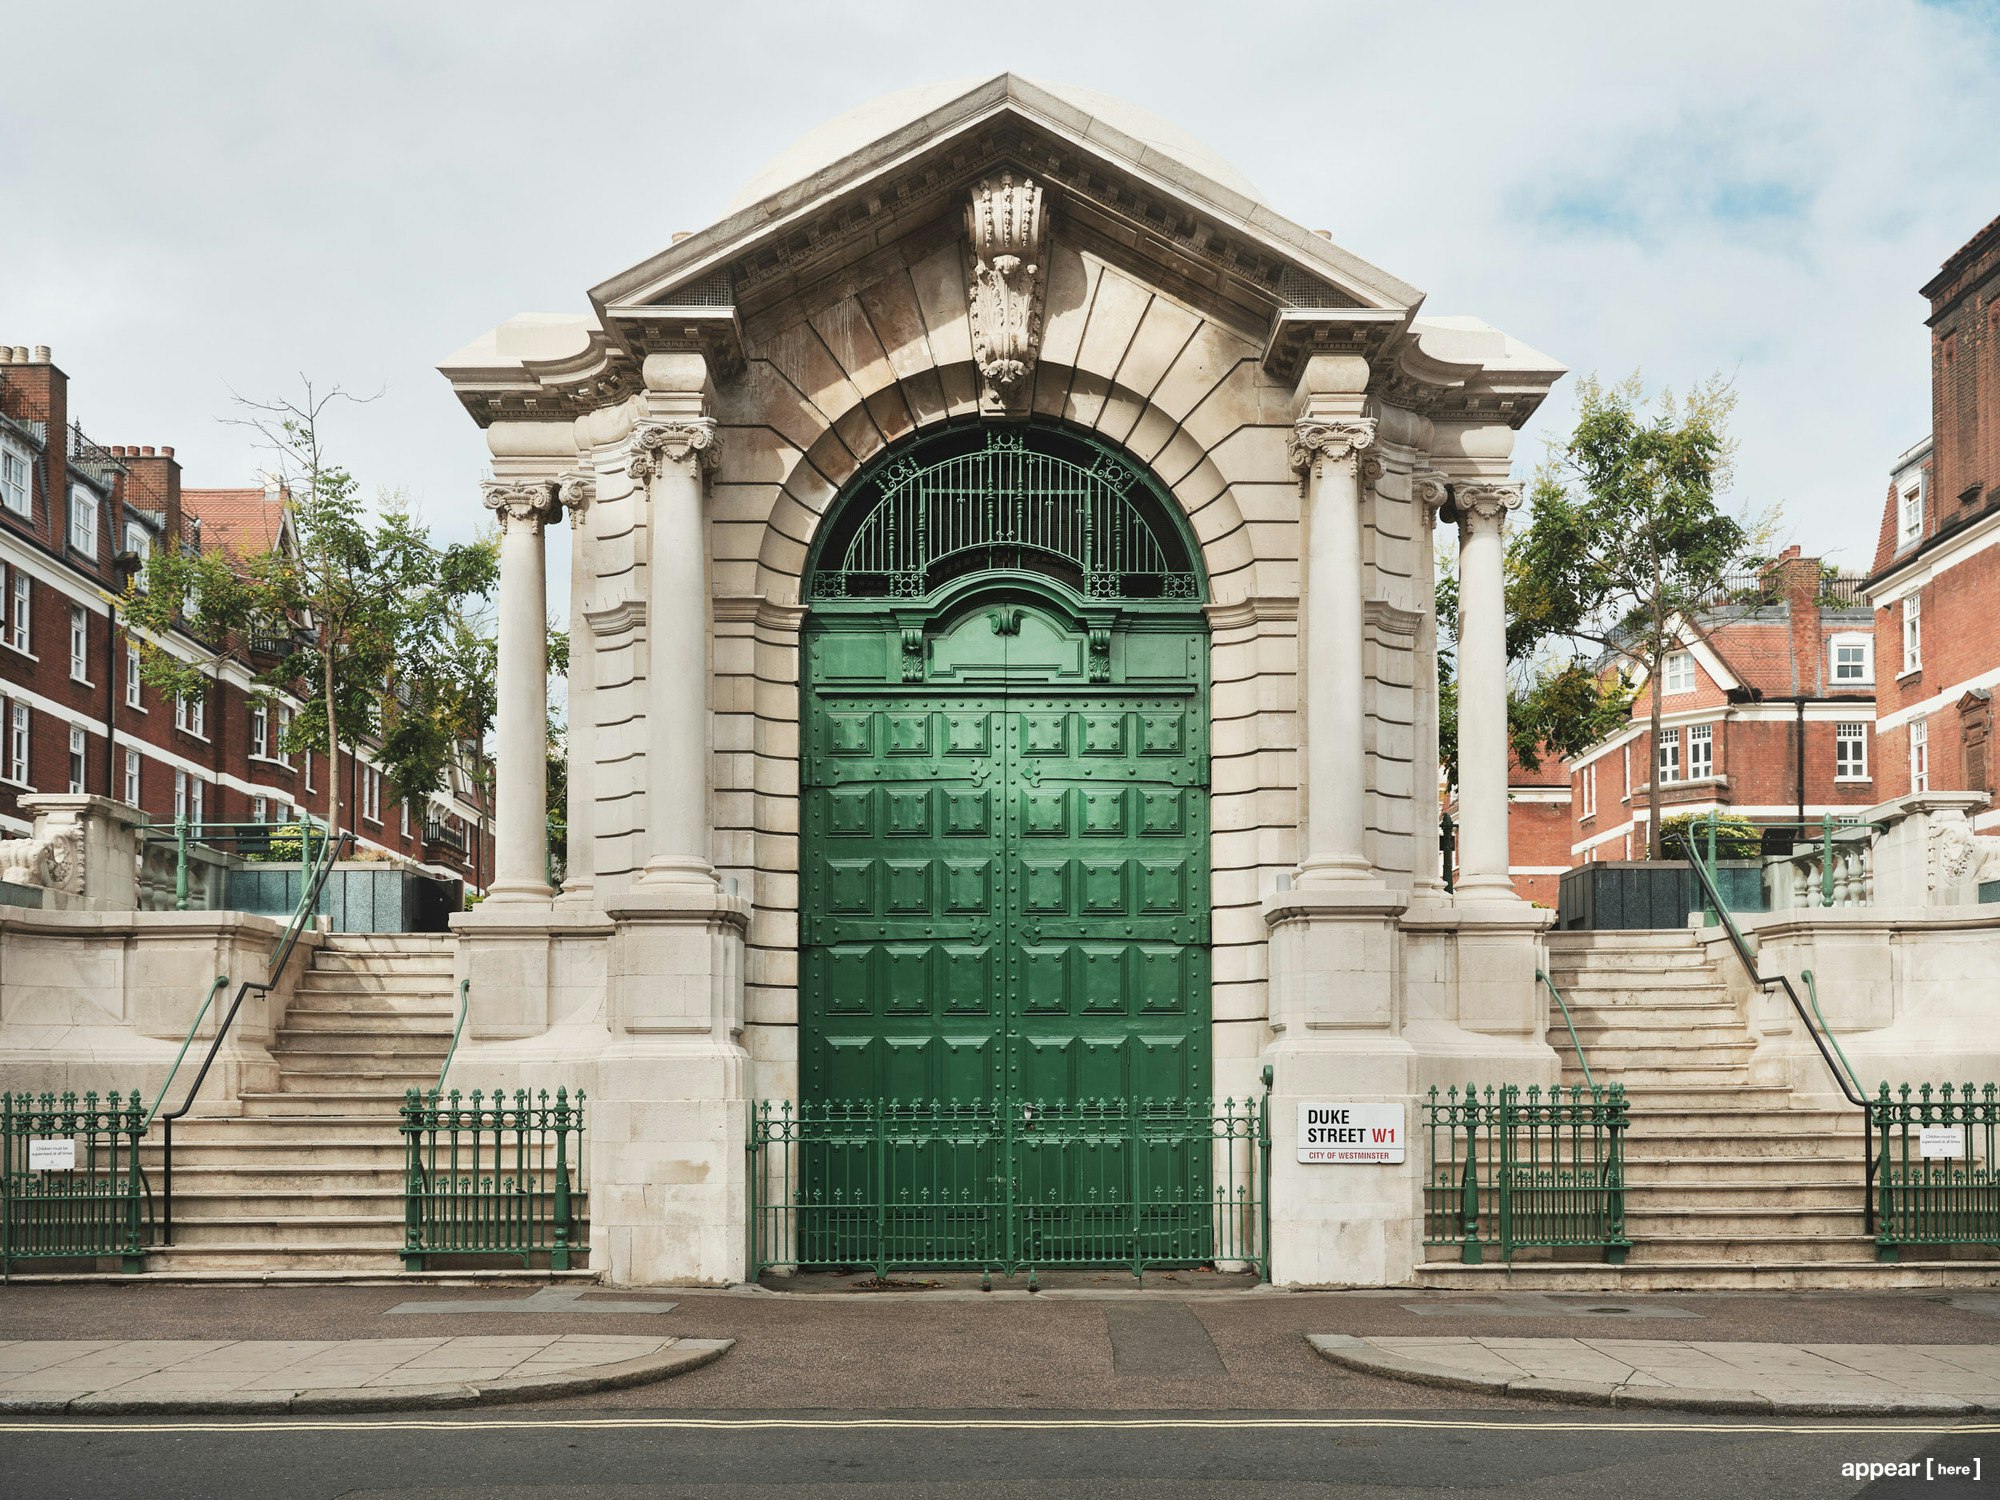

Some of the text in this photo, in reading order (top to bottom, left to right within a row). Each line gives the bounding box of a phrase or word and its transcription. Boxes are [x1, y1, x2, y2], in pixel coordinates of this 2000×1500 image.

[1308, 1110, 1349, 1124] DUKE
[1308, 1128, 1395, 1143] STREET W1
[1309, 1152, 1390, 1160] CITY OF WESTMINSTER
